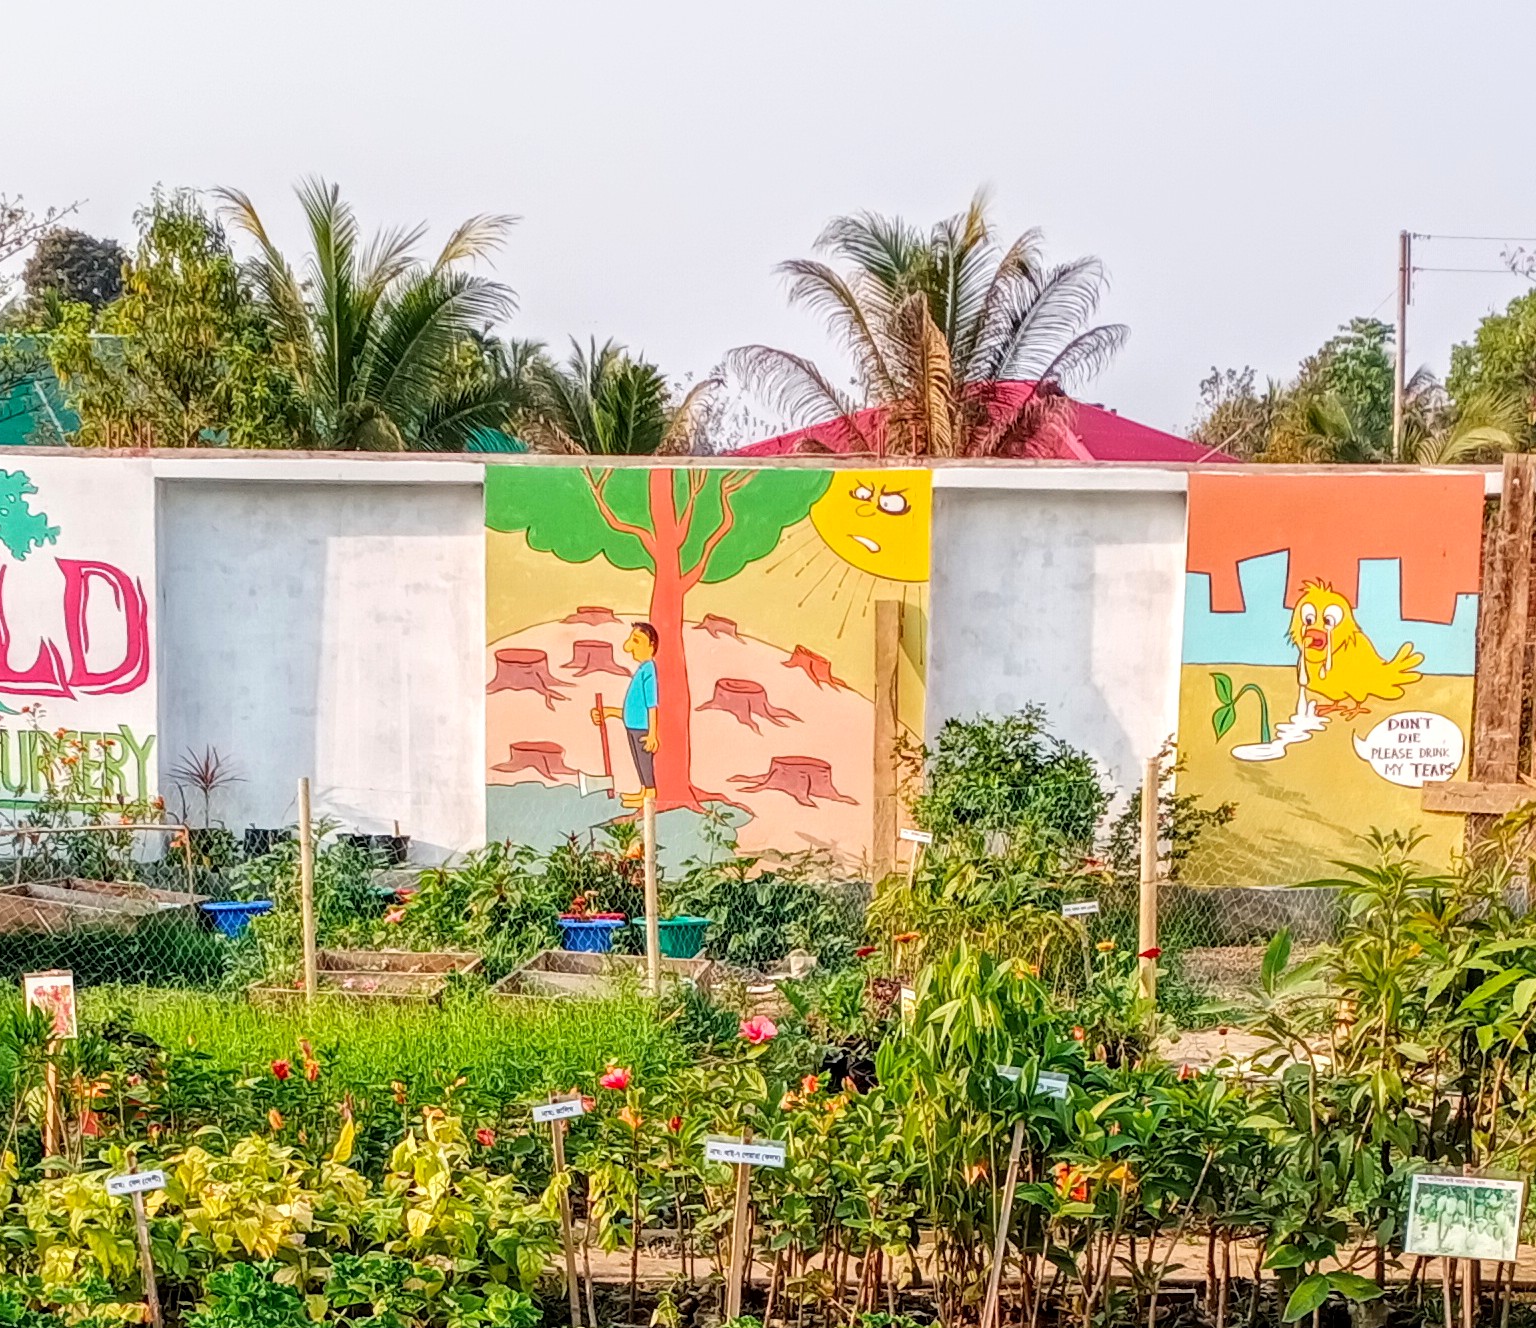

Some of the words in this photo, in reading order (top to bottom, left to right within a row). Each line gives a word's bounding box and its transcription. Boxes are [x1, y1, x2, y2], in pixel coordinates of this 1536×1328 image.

[1387, 717, 1433, 731] DON'T
[1398, 733, 1420, 743] DIE
[1371, 747, 1413, 760] PLEASE
[1419, 747, 1450, 758] DRINK
[1384, 763, 1403, 776] MY
[1410, 762, 1456, 777] TEARS
